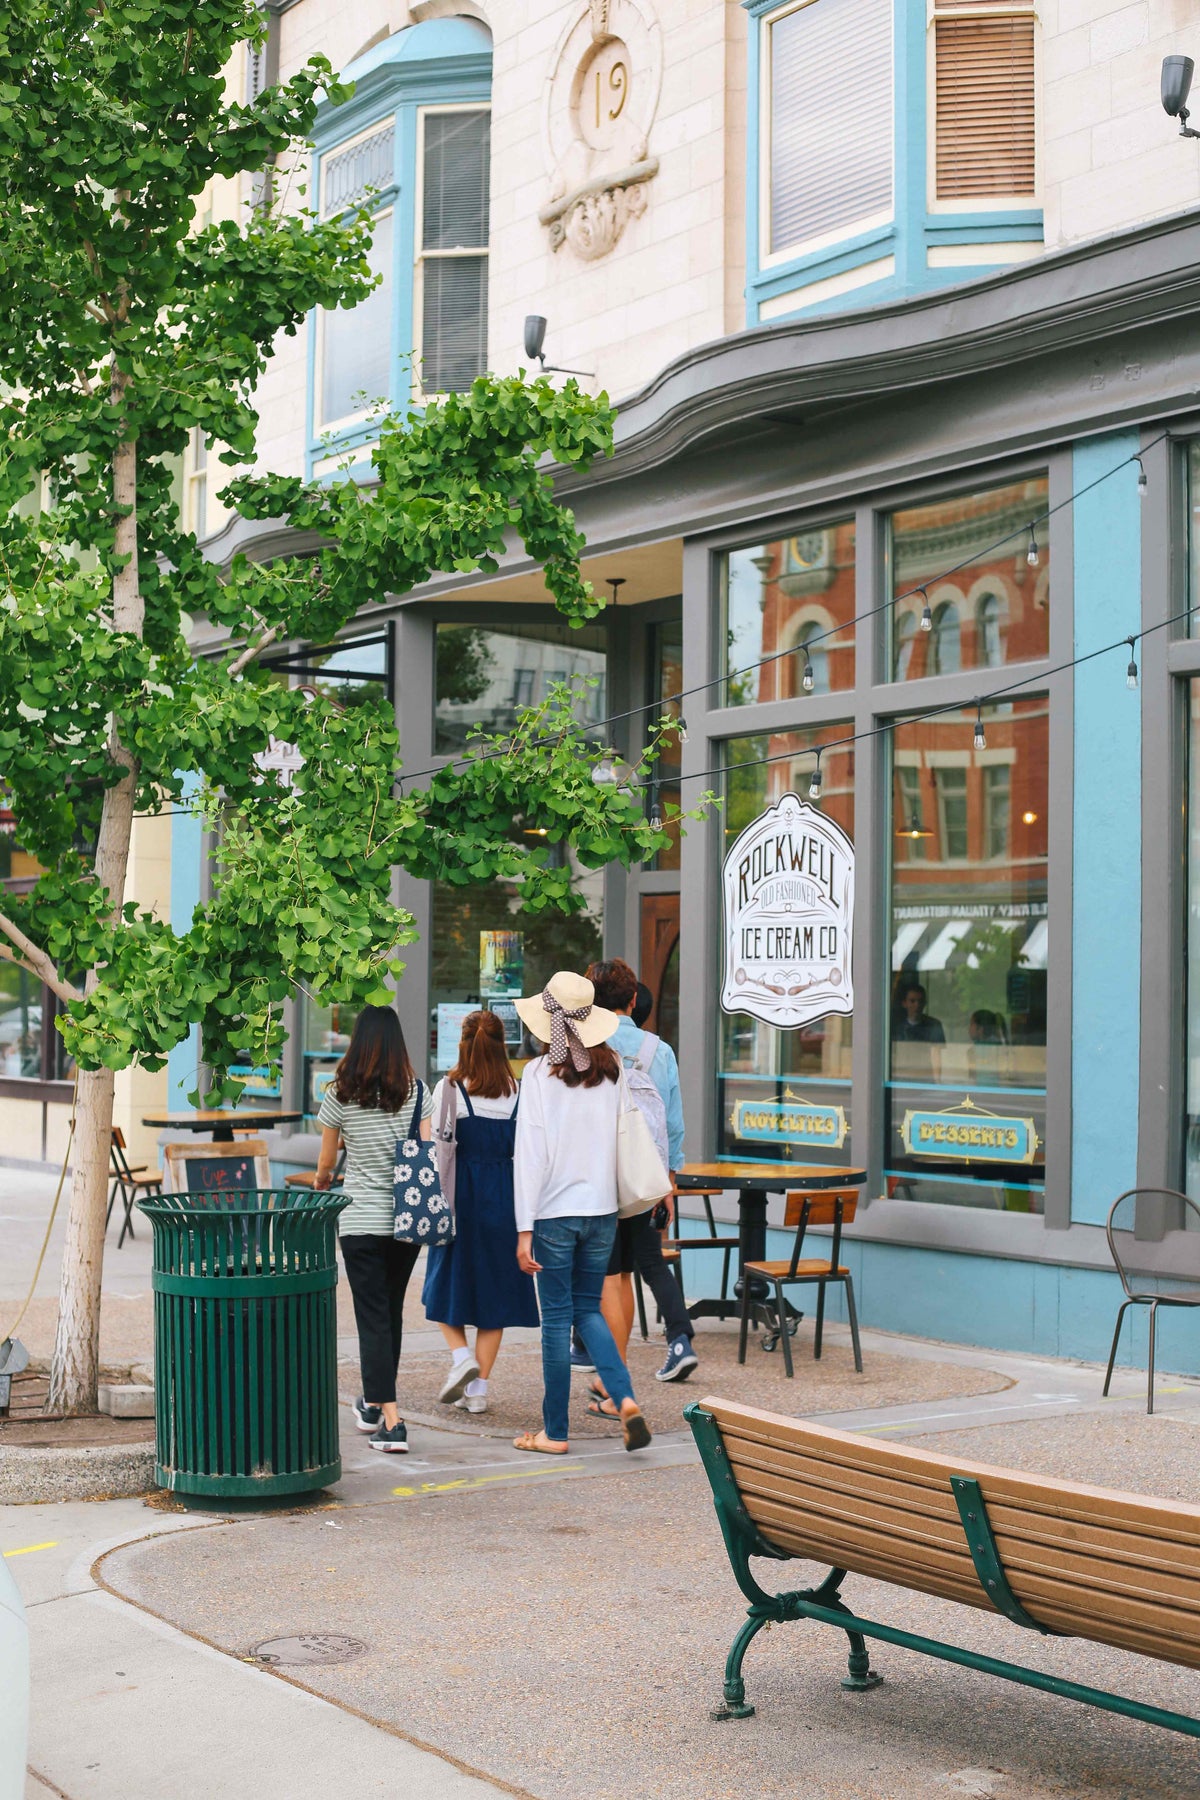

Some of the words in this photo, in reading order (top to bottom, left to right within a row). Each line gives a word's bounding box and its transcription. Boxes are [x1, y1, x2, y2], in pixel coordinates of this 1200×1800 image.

[595, 61, 628, 129] 19
[738, 833, 840, 912] ROCKWELL
[760, 884, 774, 909] OLD
[775, 880, 816, 908] FASHIONED
[741, 927, 761, 960] ICE
[766, 926, 814, 960] CREAM
[743, 1110, 835, 1135] NOVELTIES
[919, 1122, 1019, 1149] DESSERTS
